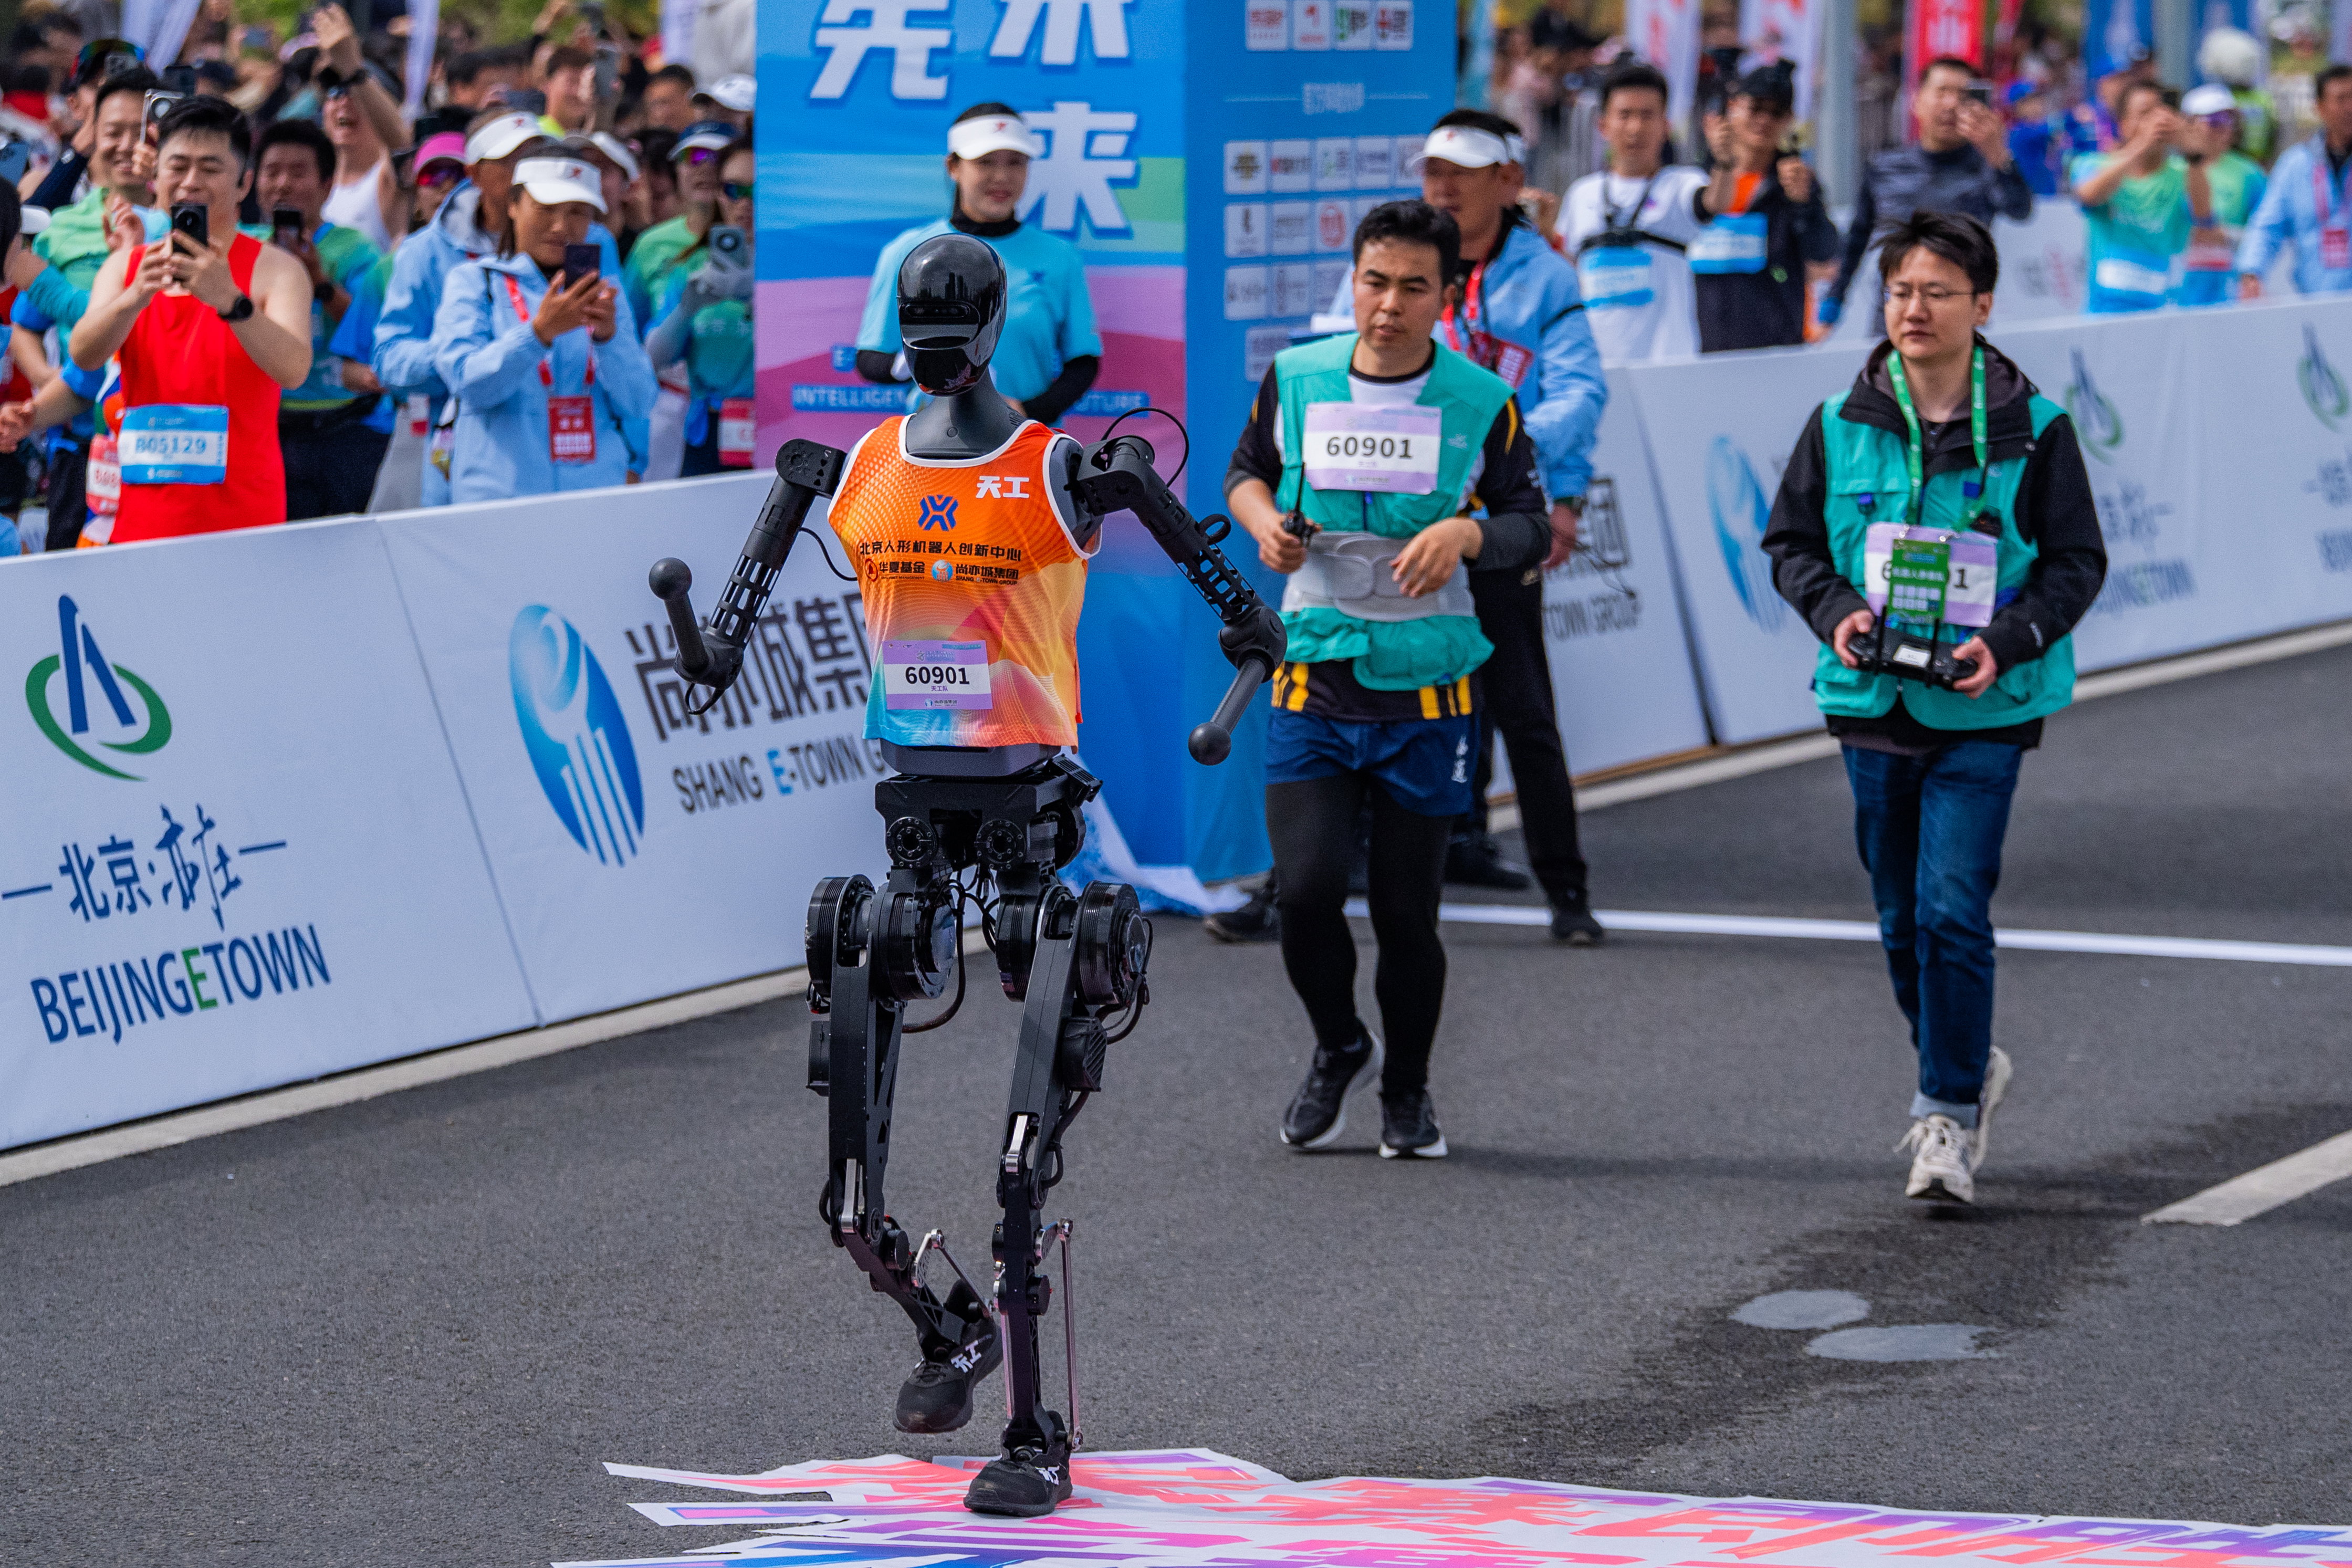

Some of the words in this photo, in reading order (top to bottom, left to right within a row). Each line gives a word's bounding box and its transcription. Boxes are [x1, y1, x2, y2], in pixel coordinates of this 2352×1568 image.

[1076, 395, 1141, 412] UTURE
[1326, 436, 1413, 460] 60901
[976, 475, 1030, 498] 天工
[860, 540, 1022, 561] 北京人形机器人创新中心
[879, 561, 925, 574] 华夏基金
[955, 563, 1019, 580] 尚亦城集团
[905, 666, 970, 685] 60901
[671, 752, 764, 814] SHANG
[30, 923, 332, 1046] BEIJINGETOWN
